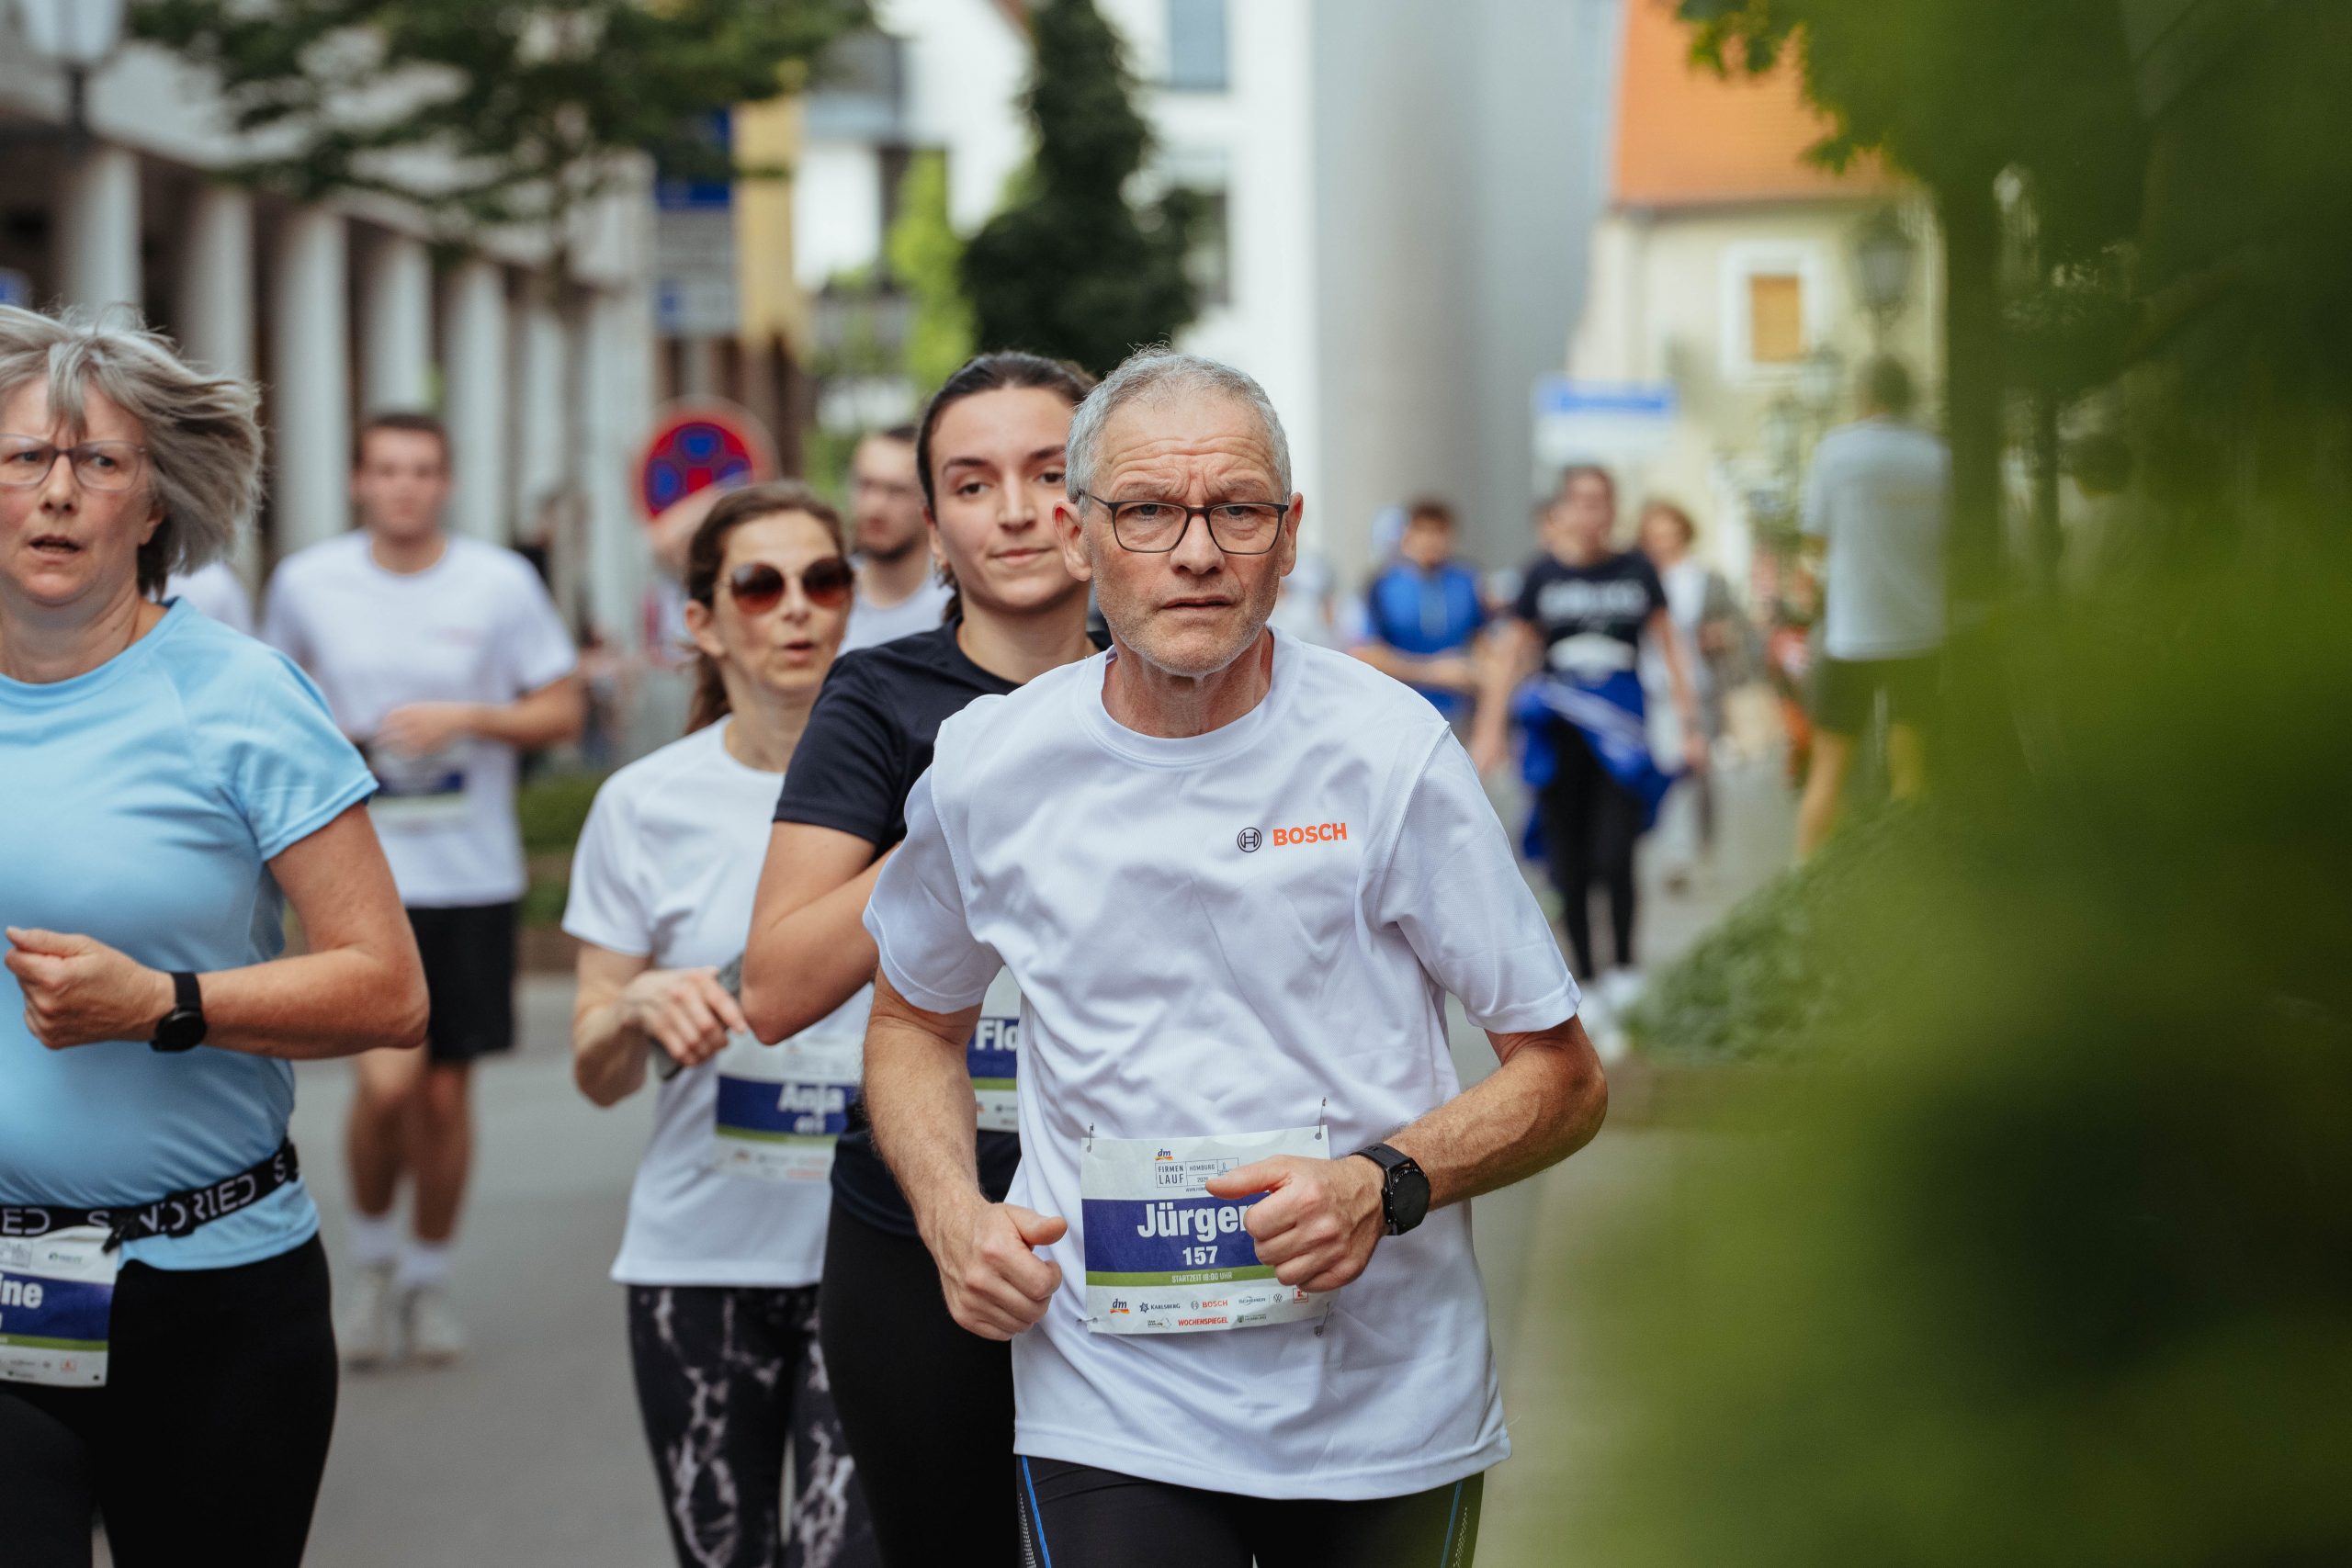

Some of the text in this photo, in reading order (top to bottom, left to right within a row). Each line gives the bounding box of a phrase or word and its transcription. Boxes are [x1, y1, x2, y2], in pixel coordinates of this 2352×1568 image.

[1272, 822, 1347, 846] BOSCH
[1158, 1149, 1171, 1157] dm
[1159, 1174, 1183, 1185] LAUF
[1182, 1246, 1218, 1266] 157
[1171, 1273, 1202, 1283] STARTZEIT
[1220, 1271, 1233, 1280] UHR
[1112, 1298, 1127, 1309] dm
[1202, 1300, 1228, 1309] BOSCH
[1178, 1316, 1228, 1326] WOCHENSPIEGEL
